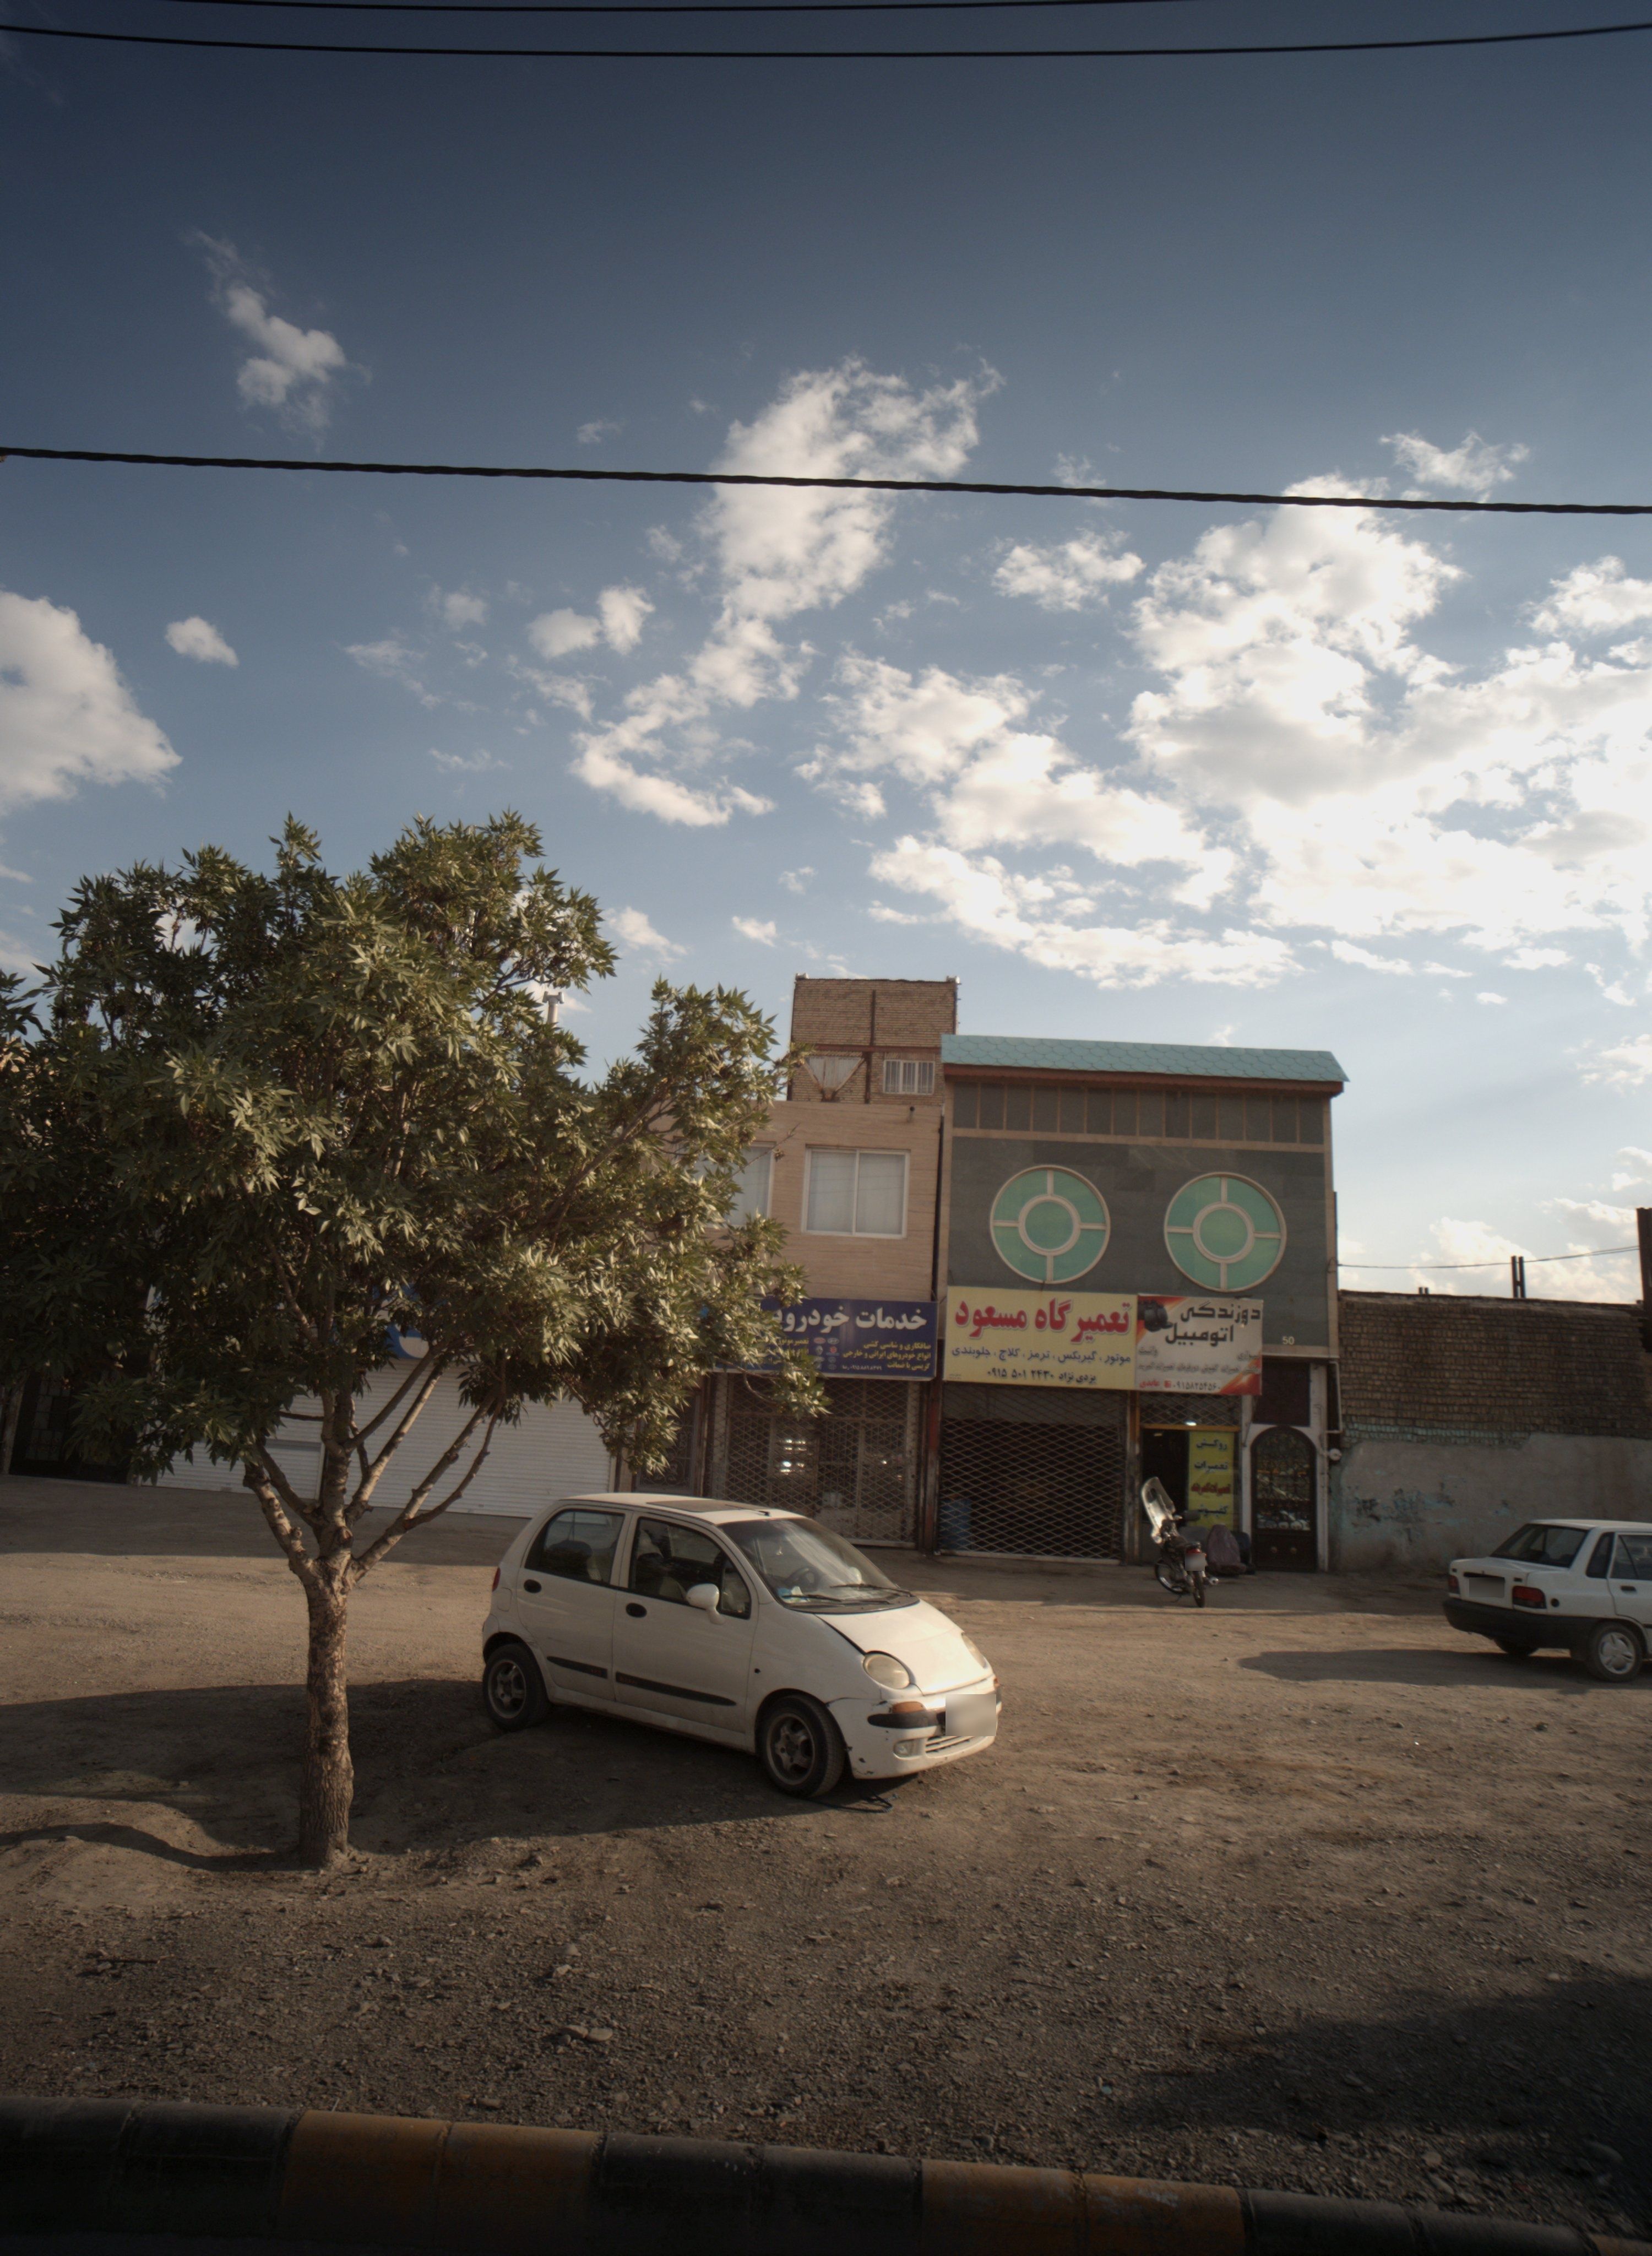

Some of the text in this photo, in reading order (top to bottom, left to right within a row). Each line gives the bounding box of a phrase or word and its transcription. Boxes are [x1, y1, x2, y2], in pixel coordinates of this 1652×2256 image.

[783, 1305, 850, 1333] خودرو
[855, 1306, 927, 1330] خدمات
[1181, 1300, 1261, 1325] دوزندگی
[954, 1298, 1131, 1343] تعمیرگاه مسعود
[1165, 1323, 1234, 1347] اتومبیل
[1282, 1336, 1295, 1345] 50
[904, 1342, 931, 1351] صافکاری
[952, 1346, 991, 1360] جلوبندی
[868, 1351, 887, 1360] ایرانی
[916, 1352, 931, 1361] انواع
[1075, 1370, 1096, 1383] یزدی
[1196, 1437, 1227, 1450] روکش
[1193, 1460, 1229, 1473] تعمیرات
